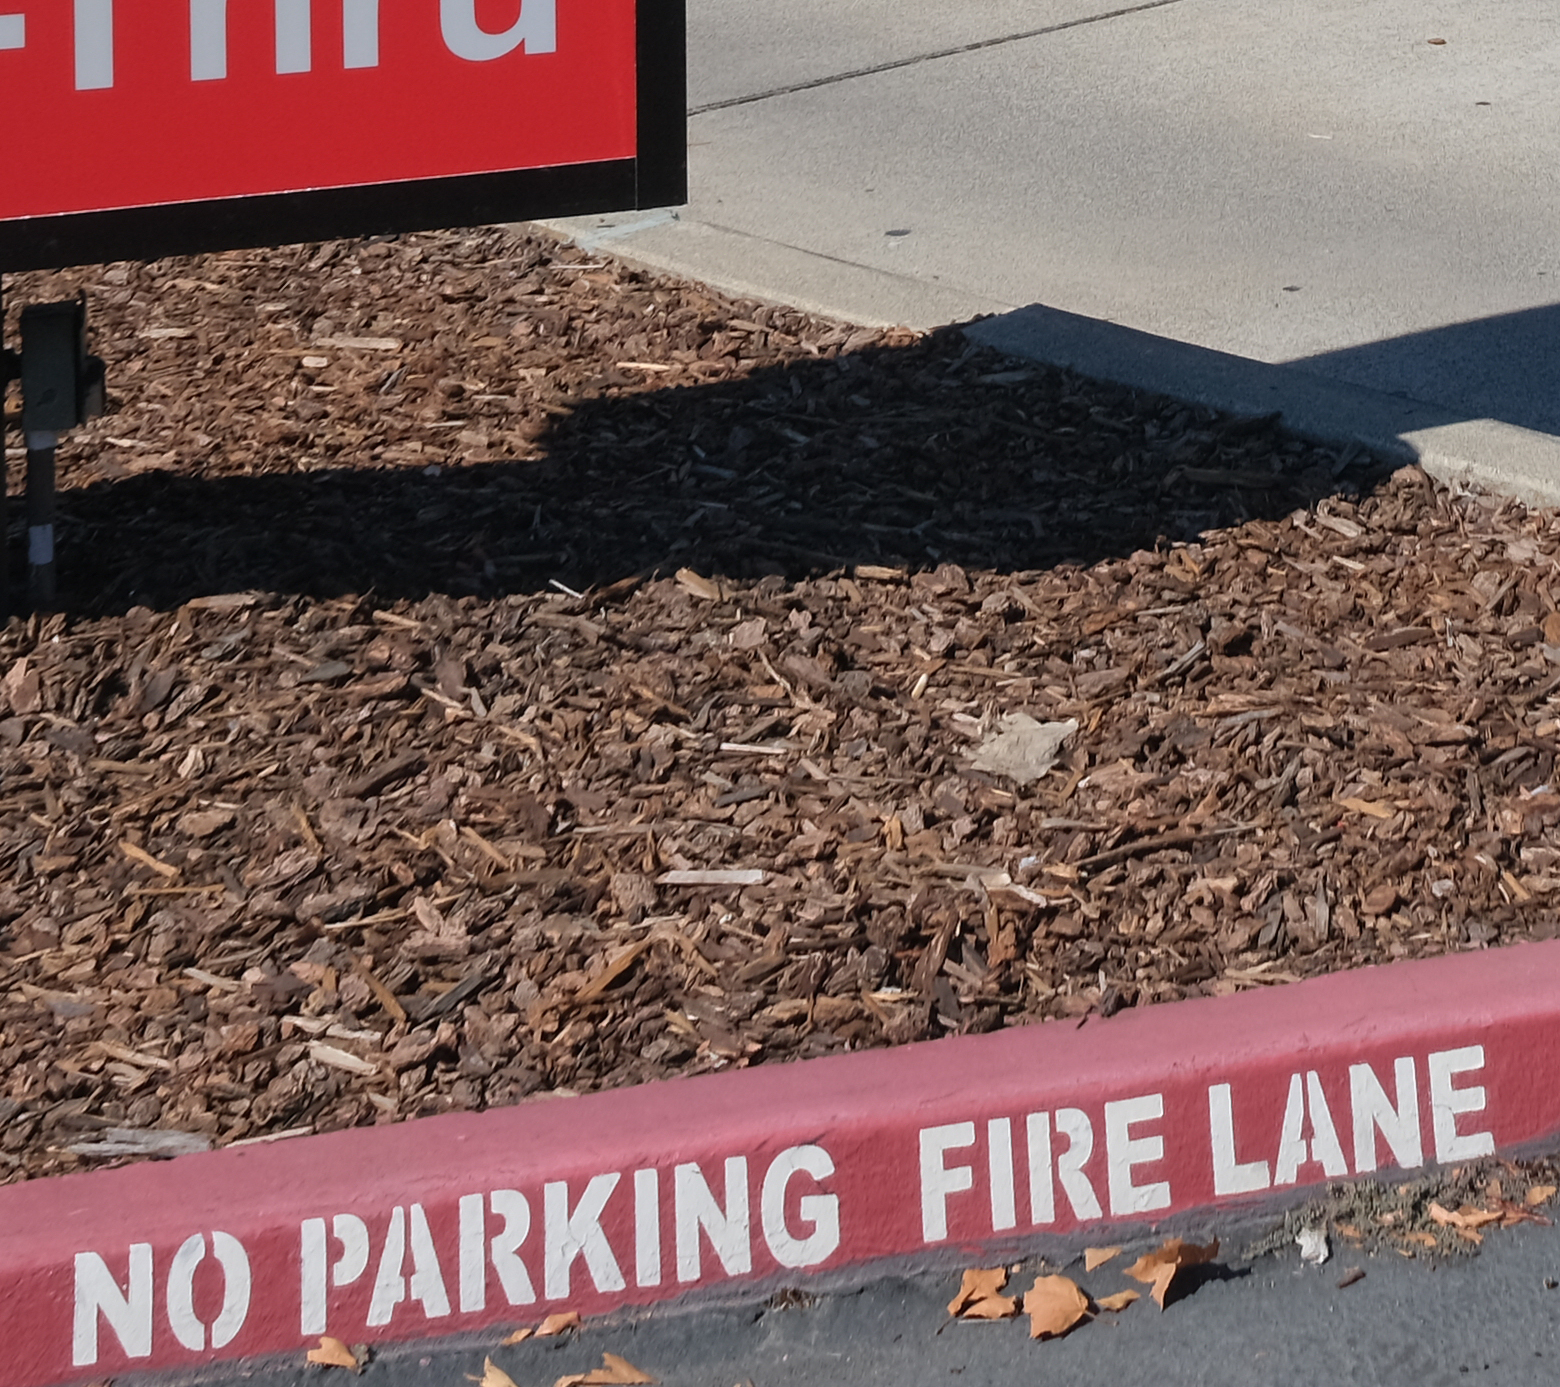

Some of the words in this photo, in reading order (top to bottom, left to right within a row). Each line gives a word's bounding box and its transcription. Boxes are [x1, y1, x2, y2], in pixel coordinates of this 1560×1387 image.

[72, 1230, 252, 1367] NO
[301, 1143, 839, 1336] PARKING
[919, 1093, 1171, 1241] FIRE
[1208, 1044, 1495, 1198] LANE
